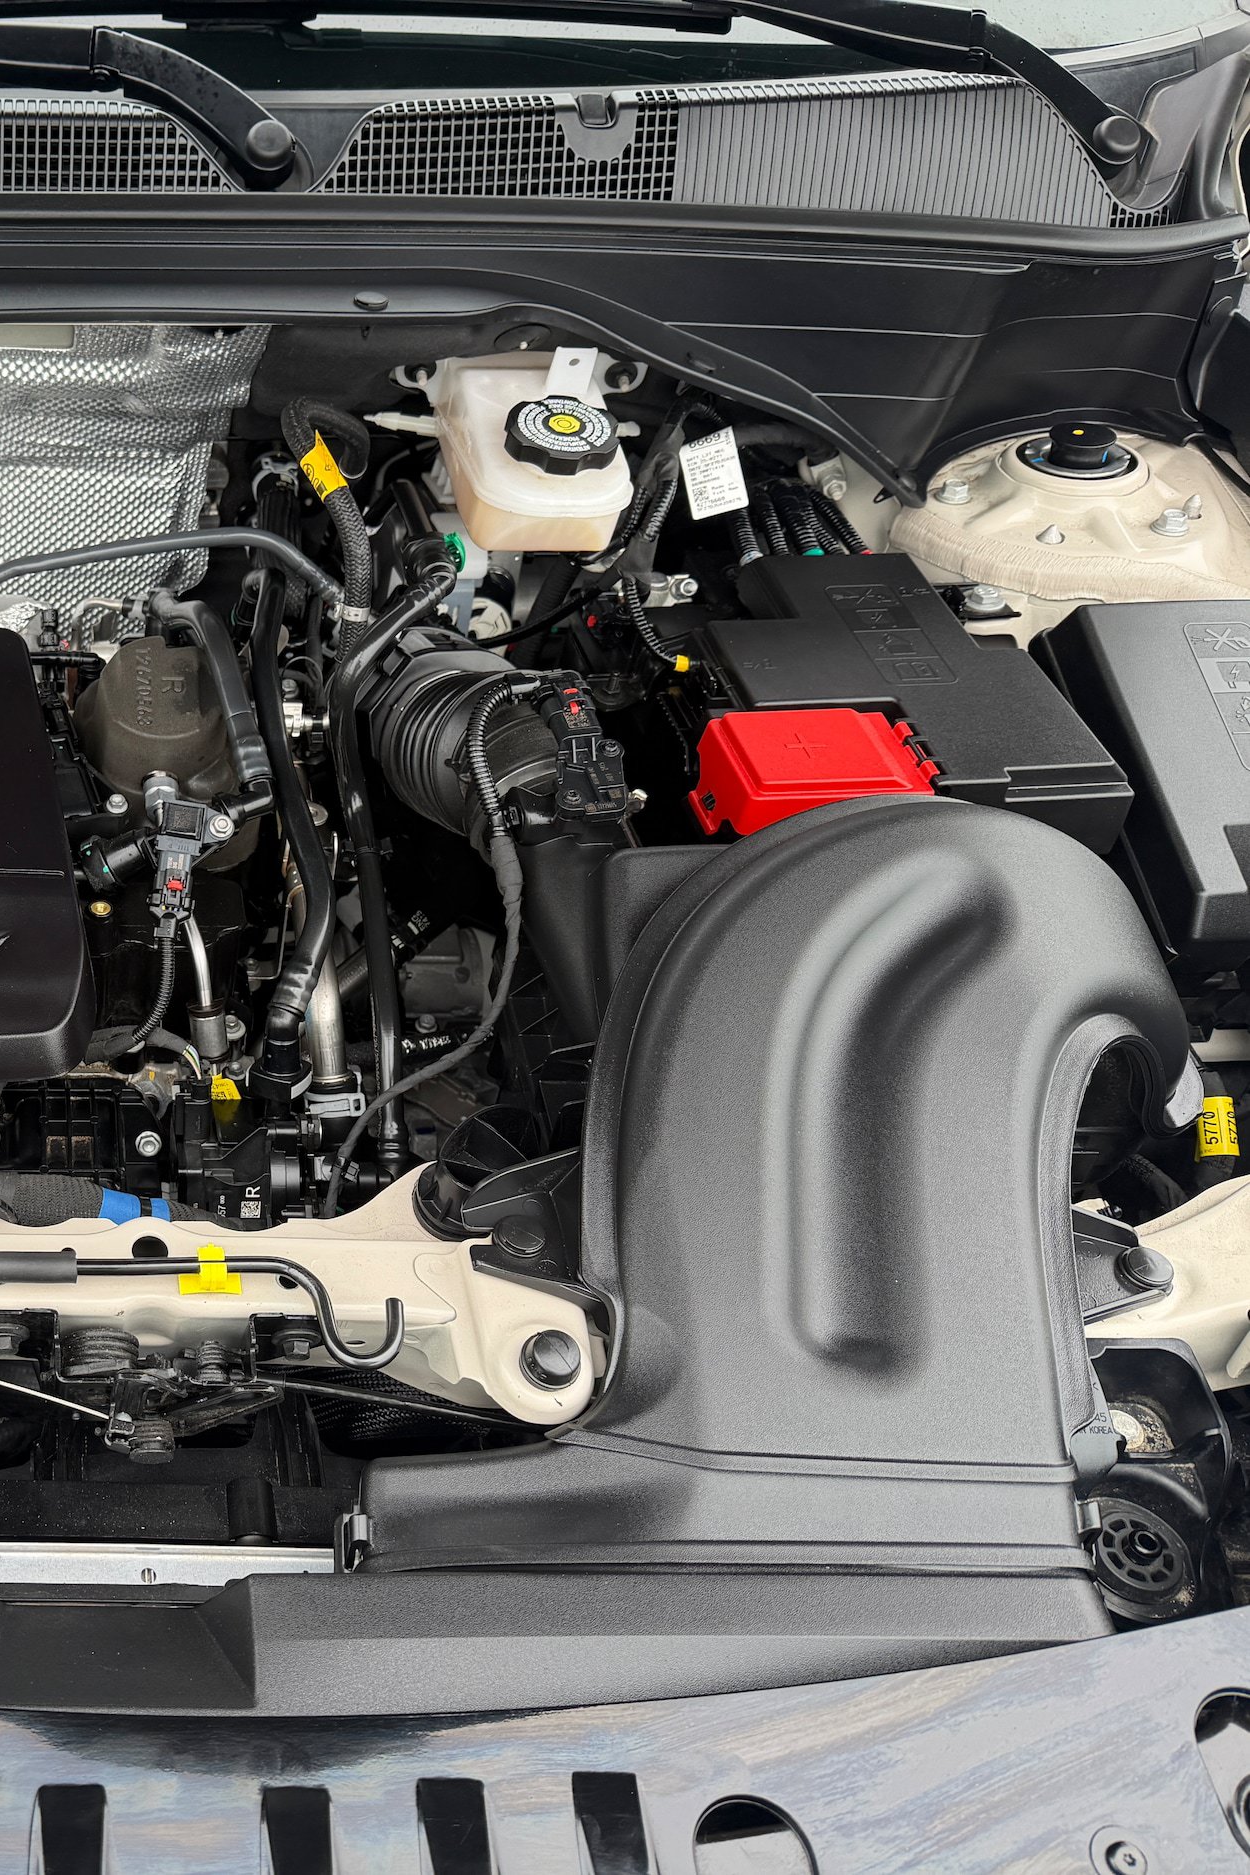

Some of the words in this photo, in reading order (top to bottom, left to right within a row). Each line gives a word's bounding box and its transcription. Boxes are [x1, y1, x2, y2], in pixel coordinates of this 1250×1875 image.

[161, 676, 185, 694] R
[1203, 1111, 1219, 1145] 5770
[246, 1186, 261, 1198] R
[1090, 1425, 1114, 1434] KOREA
